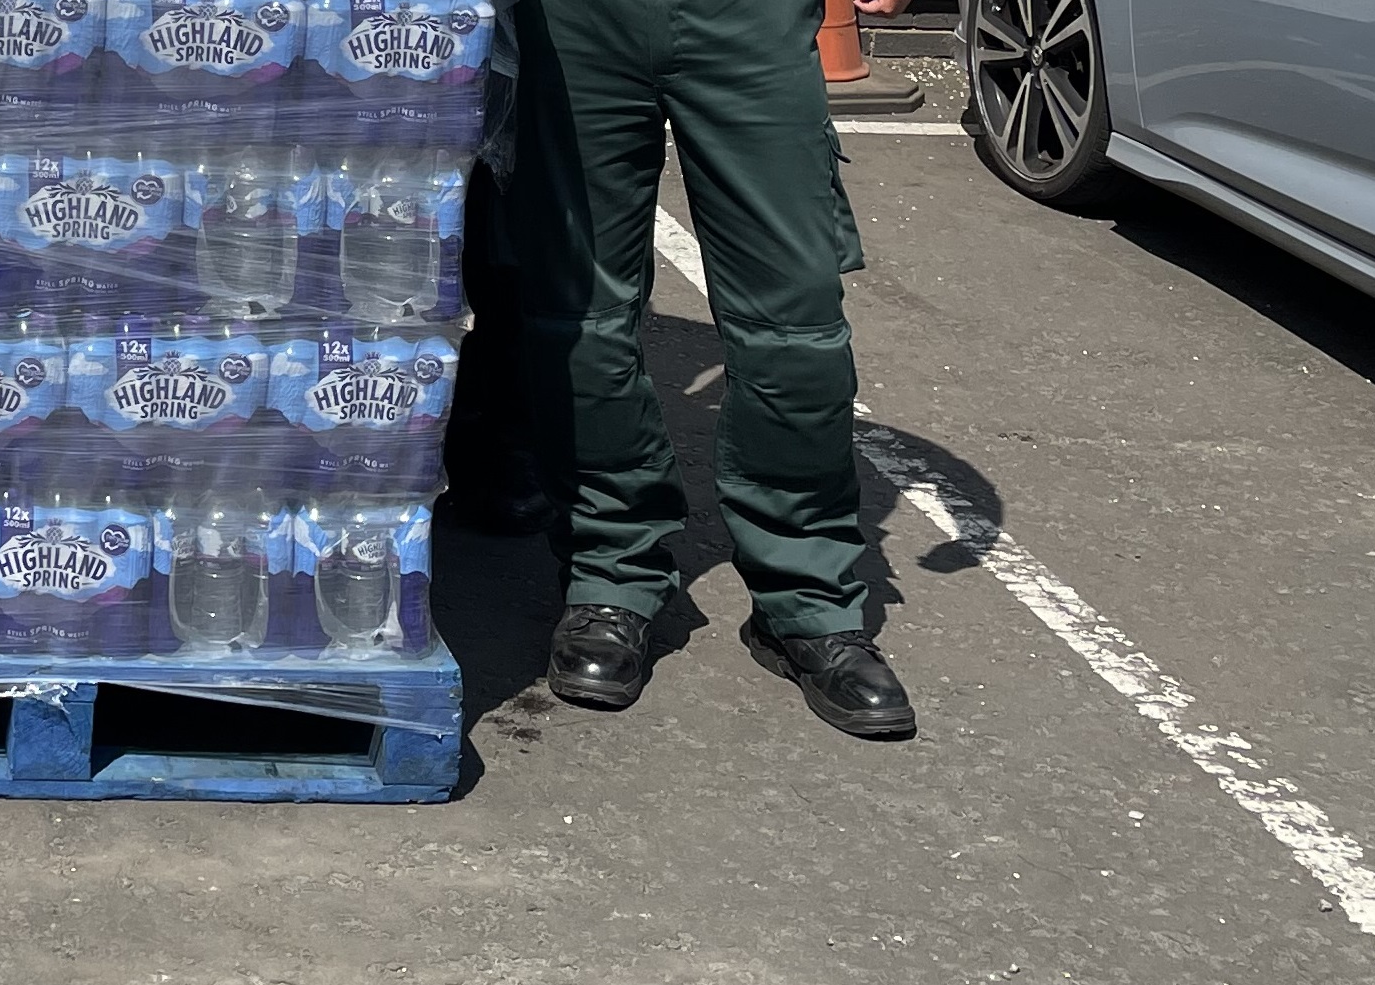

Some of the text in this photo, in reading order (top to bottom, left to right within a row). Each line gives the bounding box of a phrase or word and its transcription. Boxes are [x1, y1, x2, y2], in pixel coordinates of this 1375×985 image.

[148, 22, 264, 57] HIGHLAND
[347, 28, 456, 60] HIGHLAND
[175, 45, 234, 65] SPRING
[374, 51, 431, 70] SPRING
[380, 107, 415, 117] SPRING
[33, 158, 59, 172] 12x
[25, 197, 139, 231] HIGHLAND
[52, 221, 110, 240] SPRING
[58, 276, 94, 288] SPRING
[120, 340, 147, 354] 12x
[323, 340, 349, 355] 12x
[113, 378, 226, 410] HIGHLAND
[313, 379, 419, 411] HIGHLAND
[140, 401, 198, 420] SPRING
[339, 402, 396, 421] SPRING
[145, 454, 181, 466] SPRING
[343, 454, 377, 466] SPRING
[4, 507, 30, 521] 12x
[3, 520, 30, 528] 500ml
[23, 571, 80, 590] SPRING
[30, 626, 65, 637] SPRING
